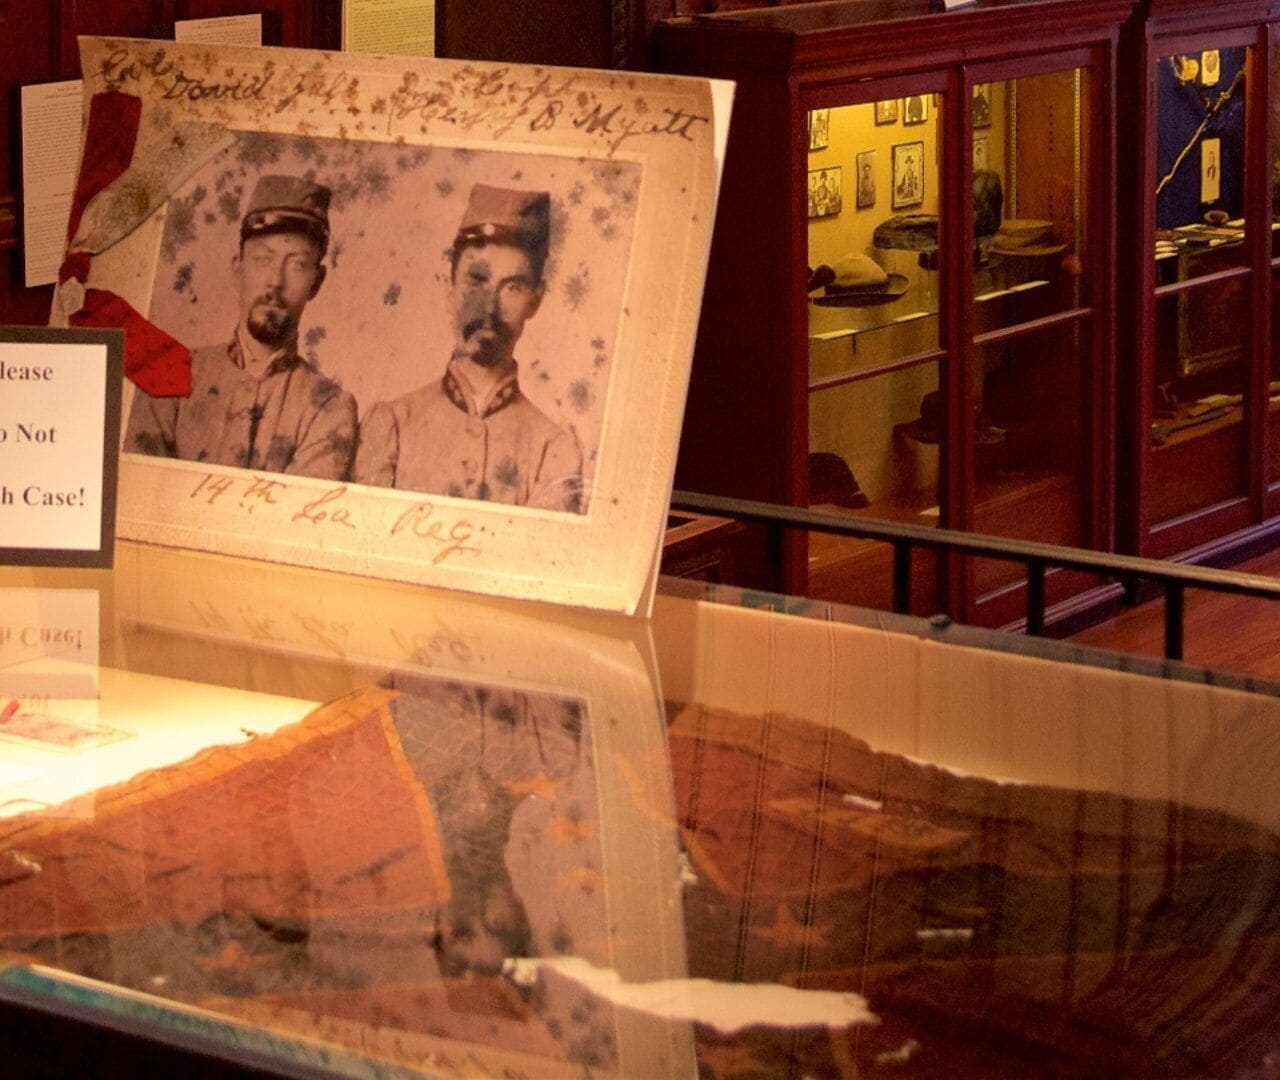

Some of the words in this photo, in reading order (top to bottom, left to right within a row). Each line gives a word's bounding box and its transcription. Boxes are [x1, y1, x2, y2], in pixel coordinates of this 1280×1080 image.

[163, 61, 276, 102] David
[16, 423, 57, 444] Not
[23, 486, 86, 507] Case!
